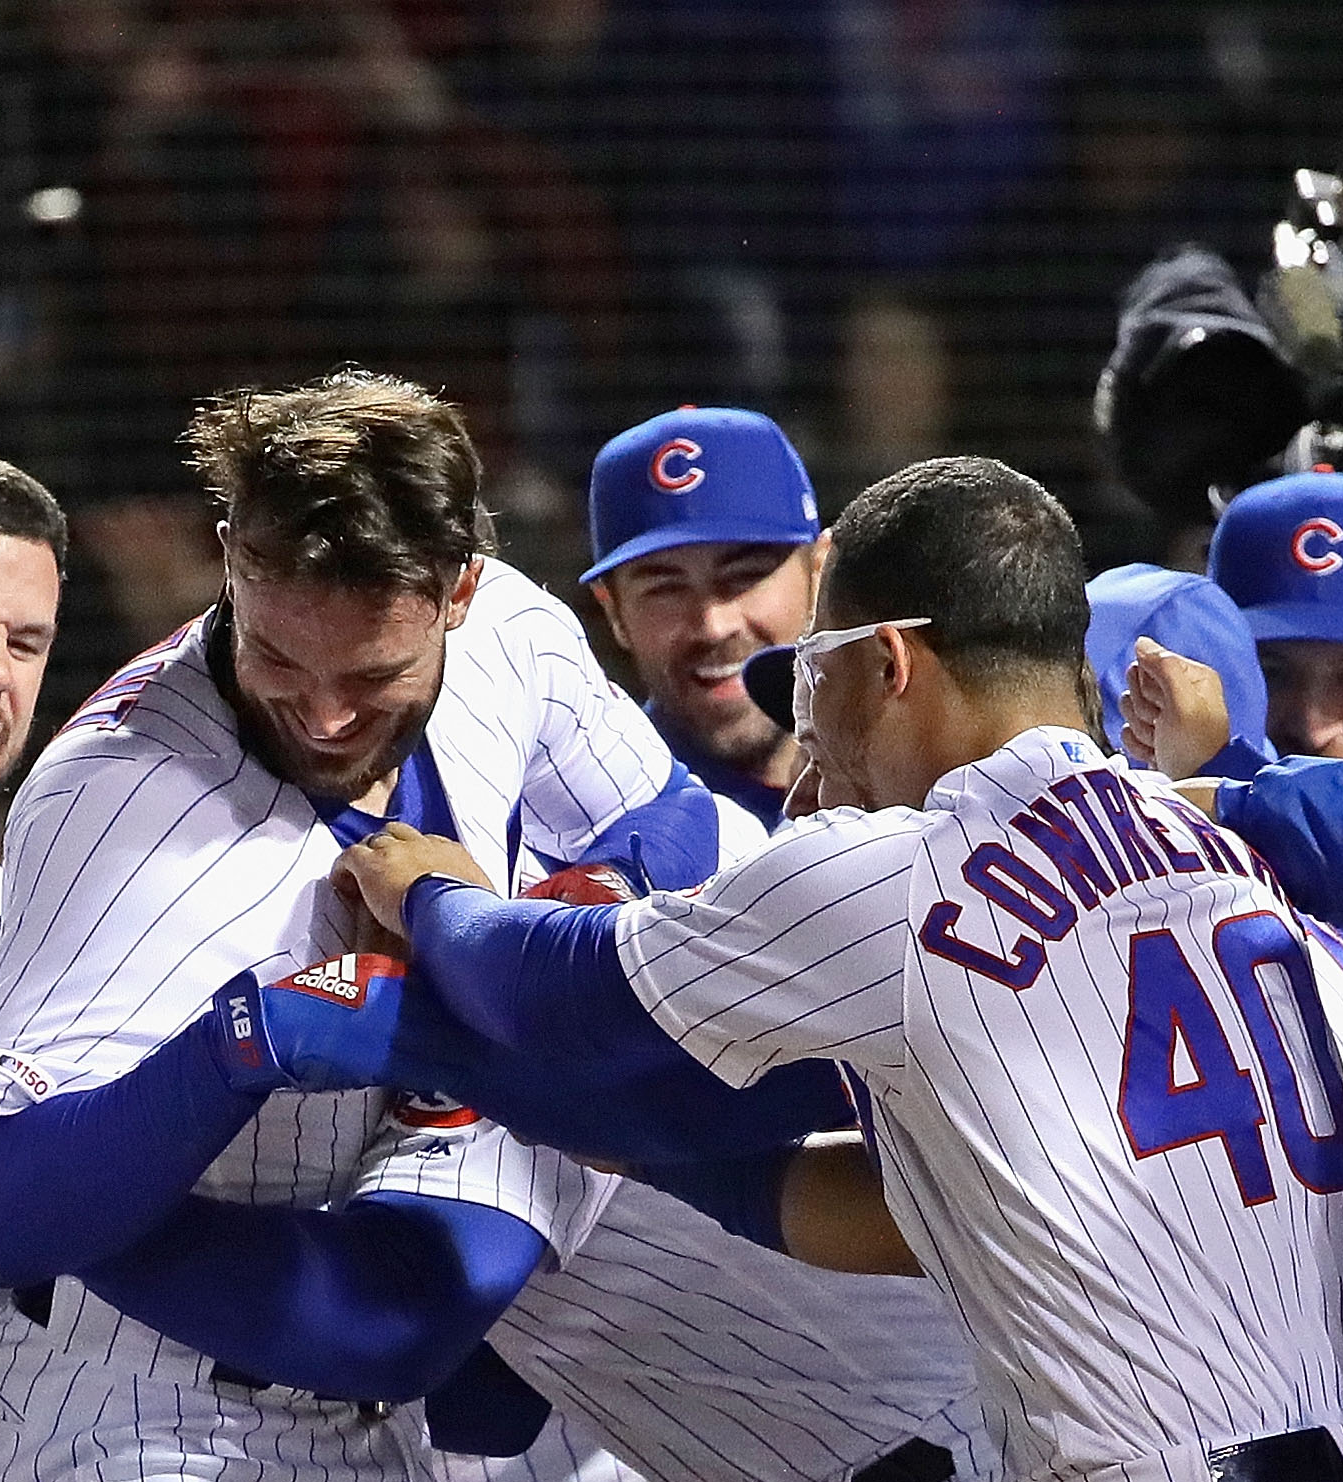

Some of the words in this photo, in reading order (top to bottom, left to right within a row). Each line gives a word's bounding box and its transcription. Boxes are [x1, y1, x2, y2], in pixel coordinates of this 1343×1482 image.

[649, 437, 706, 496] C
[293, 967, 360, 1000] adidas
[20, 1065, 49, 1096] 150
